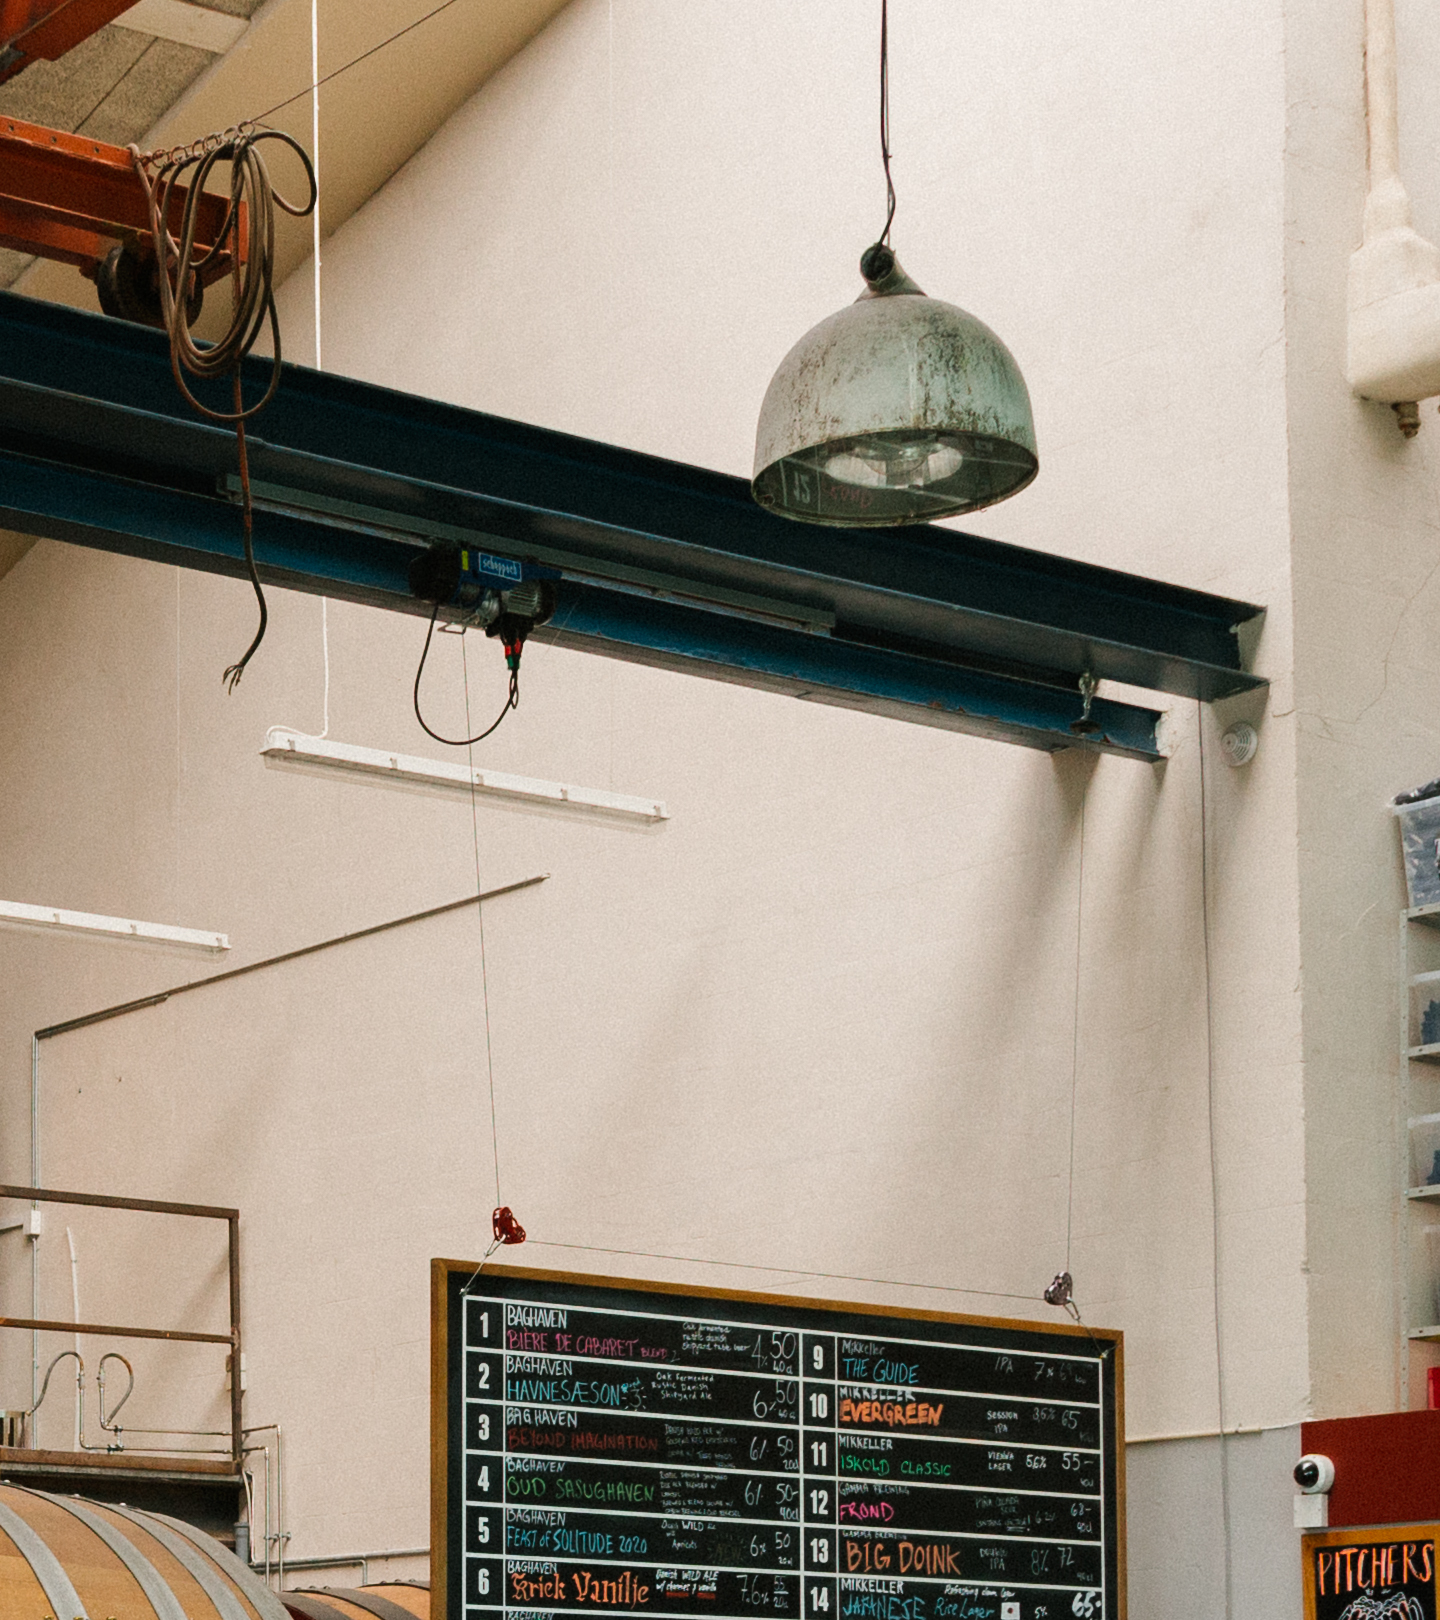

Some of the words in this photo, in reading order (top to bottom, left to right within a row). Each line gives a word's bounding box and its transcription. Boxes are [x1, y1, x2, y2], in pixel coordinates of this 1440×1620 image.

[480, 1313, 489, 1338] 1
[507, 1305, 567, 1329] BAGHAVEN
[507, 1327, 548, 1350] BIÈRE
[555, 1335, 571, 1351] DE
[575, 1335, 639, 1358] CABARET
[770, 1331, 796, 1359] 50
[813, 1345, 824, 1370] 9
[994, 1356, 1014, 1374] IPA
[479, 1363, 490, 1390] 2
[506, 1355, 573, 1377] BAGHAVEN
[843, 1358, 868, 1379] THE
[873, 1360, 919, 1384] GUIDE
[507, 1380, 620, 1407] HAVNESÆSON
[776, 1379, 797, 1405] 50
[809, 1393, 828, 1419] 10
[839, 1399, 944, 1427] EVERGREEN
[479, 1415, 490, 1440] 3
[506, 1407, 577, 1429] BAGHAVEN
[994, 1424, 1008, 1434] IPA
[1061, 1409, 1081, 1430] 65
[508, 1430, 566, 1449] BEYOND
[571, 1432, 658, 1450] IMAGINATION
[777, 1435, 794, 1457] 50
[810, 1441, 827, 1467] 11
[838, 1435, 893, 1451] MIKKELLER
[478, 1466, 489, 1491] 4
[506, 1457, 565, 1473] BAGHAVEN
[840, 1456, 890, 1477] ISKOLD
[900, 1460, 952, 1477] CLASSIC
[507, 1477, 546, 1497] OUD
[810, 1490, 828, 1515] 12
[840, 1501, 895, 1522] FROND
[478, 1518, 490, 1543] 5
[506, 1508, 566, 1526] BAGHAVEN
[682, 1521, 704, 1532] WILD
[507, 1525, 537, 1549] FEAST
[552, 1528, 614, 1555] SOLITUDE
[619, 1535, 647, 1554] 2020
[775, 1531, 791, 1550] 50
[810, 1538, 829, 1563] 13
[846, 1540, 891, 1573] BIG
[899, 1542, 962, 1576] DOINK
[1318, 1539, 1434, 1596] PITCHERS
[478, 1568, 489, 1594] 6
[507, 1559, 558, 1575] BAGHAVEN
[682, 1570, 701, 1580] WILD
[572, 1571, 650, 1609] Vanilje
[810, 1586, 829, 1612] 14
[841, 1578, 904, 1595] MIKKELLER
